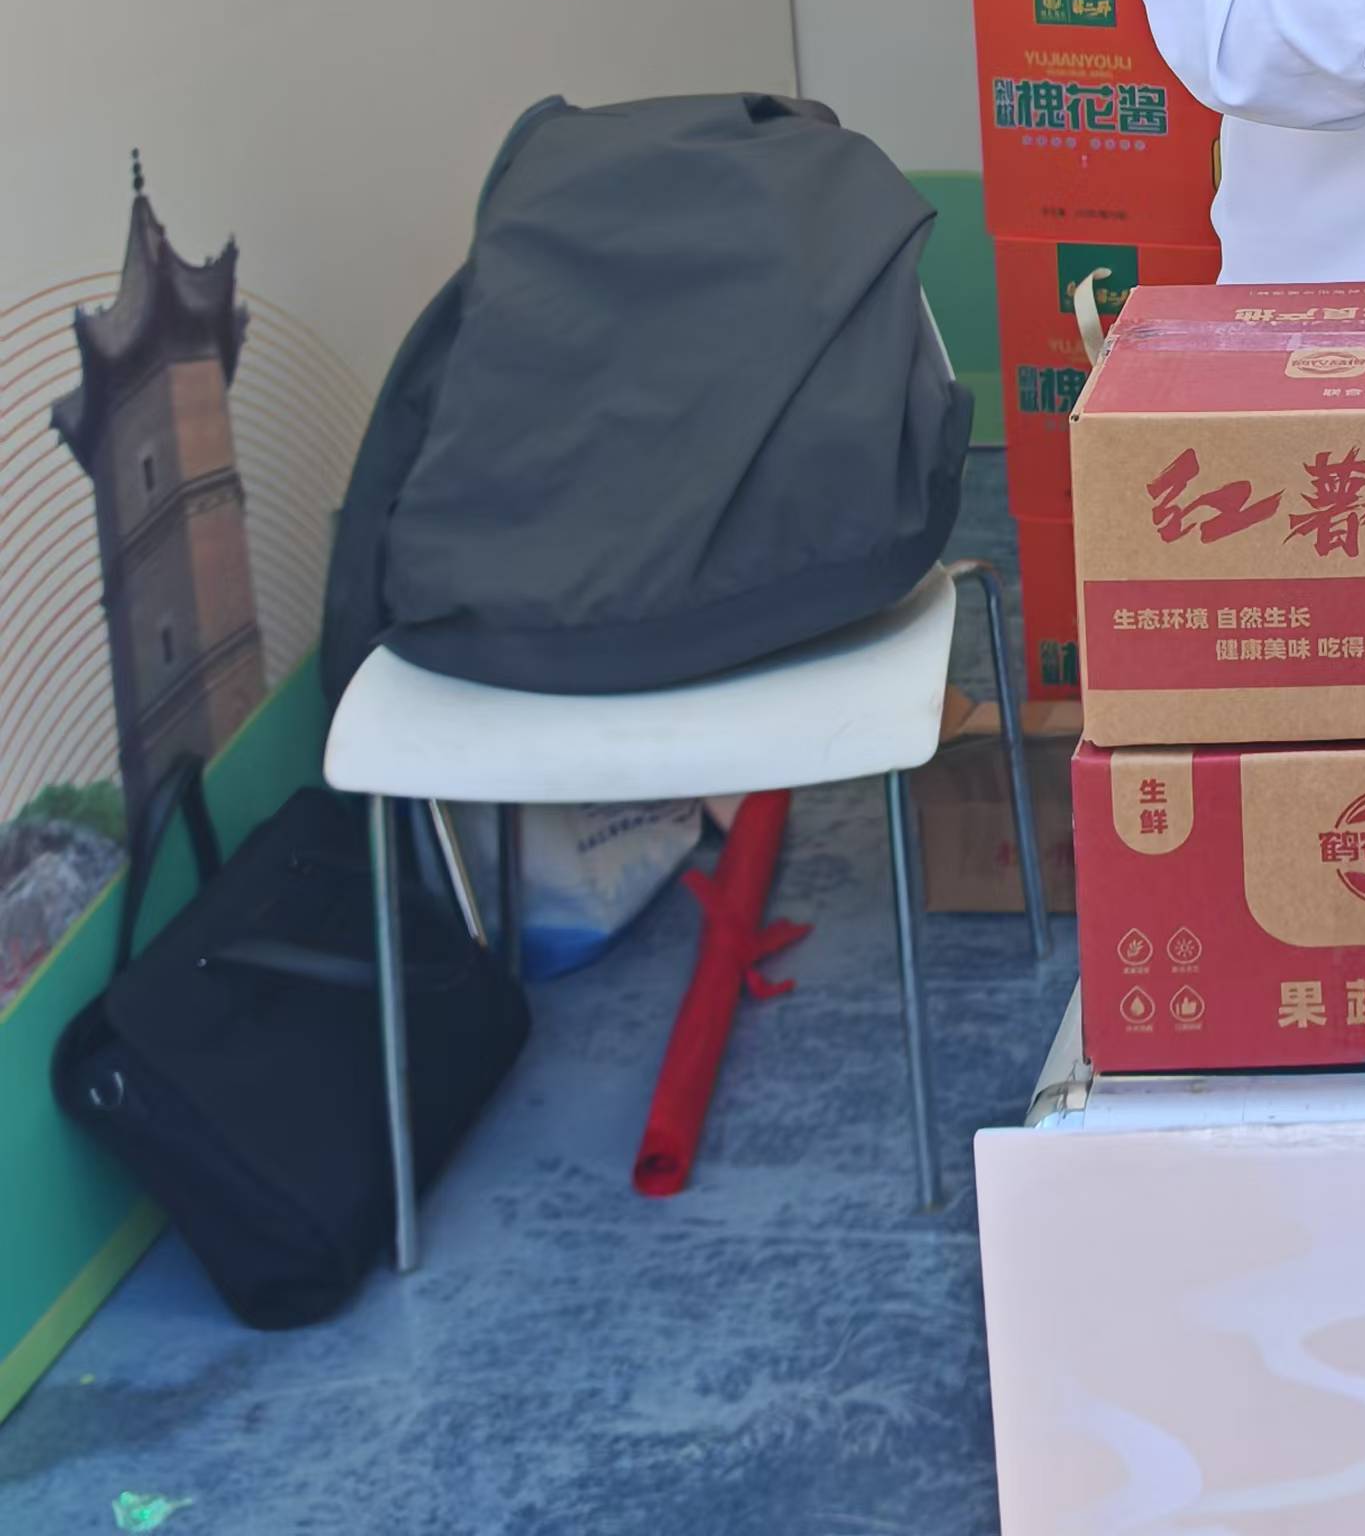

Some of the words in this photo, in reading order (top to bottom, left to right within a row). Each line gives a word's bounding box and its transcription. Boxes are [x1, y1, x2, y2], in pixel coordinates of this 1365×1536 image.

[1113, 606, 1209, 631] 生态环境
[1216, 605, 1311, 630] 自然生长
[1215, 636, 1311, 661] 健康美味
[1139, 778, 1169, 835] 生鲜
